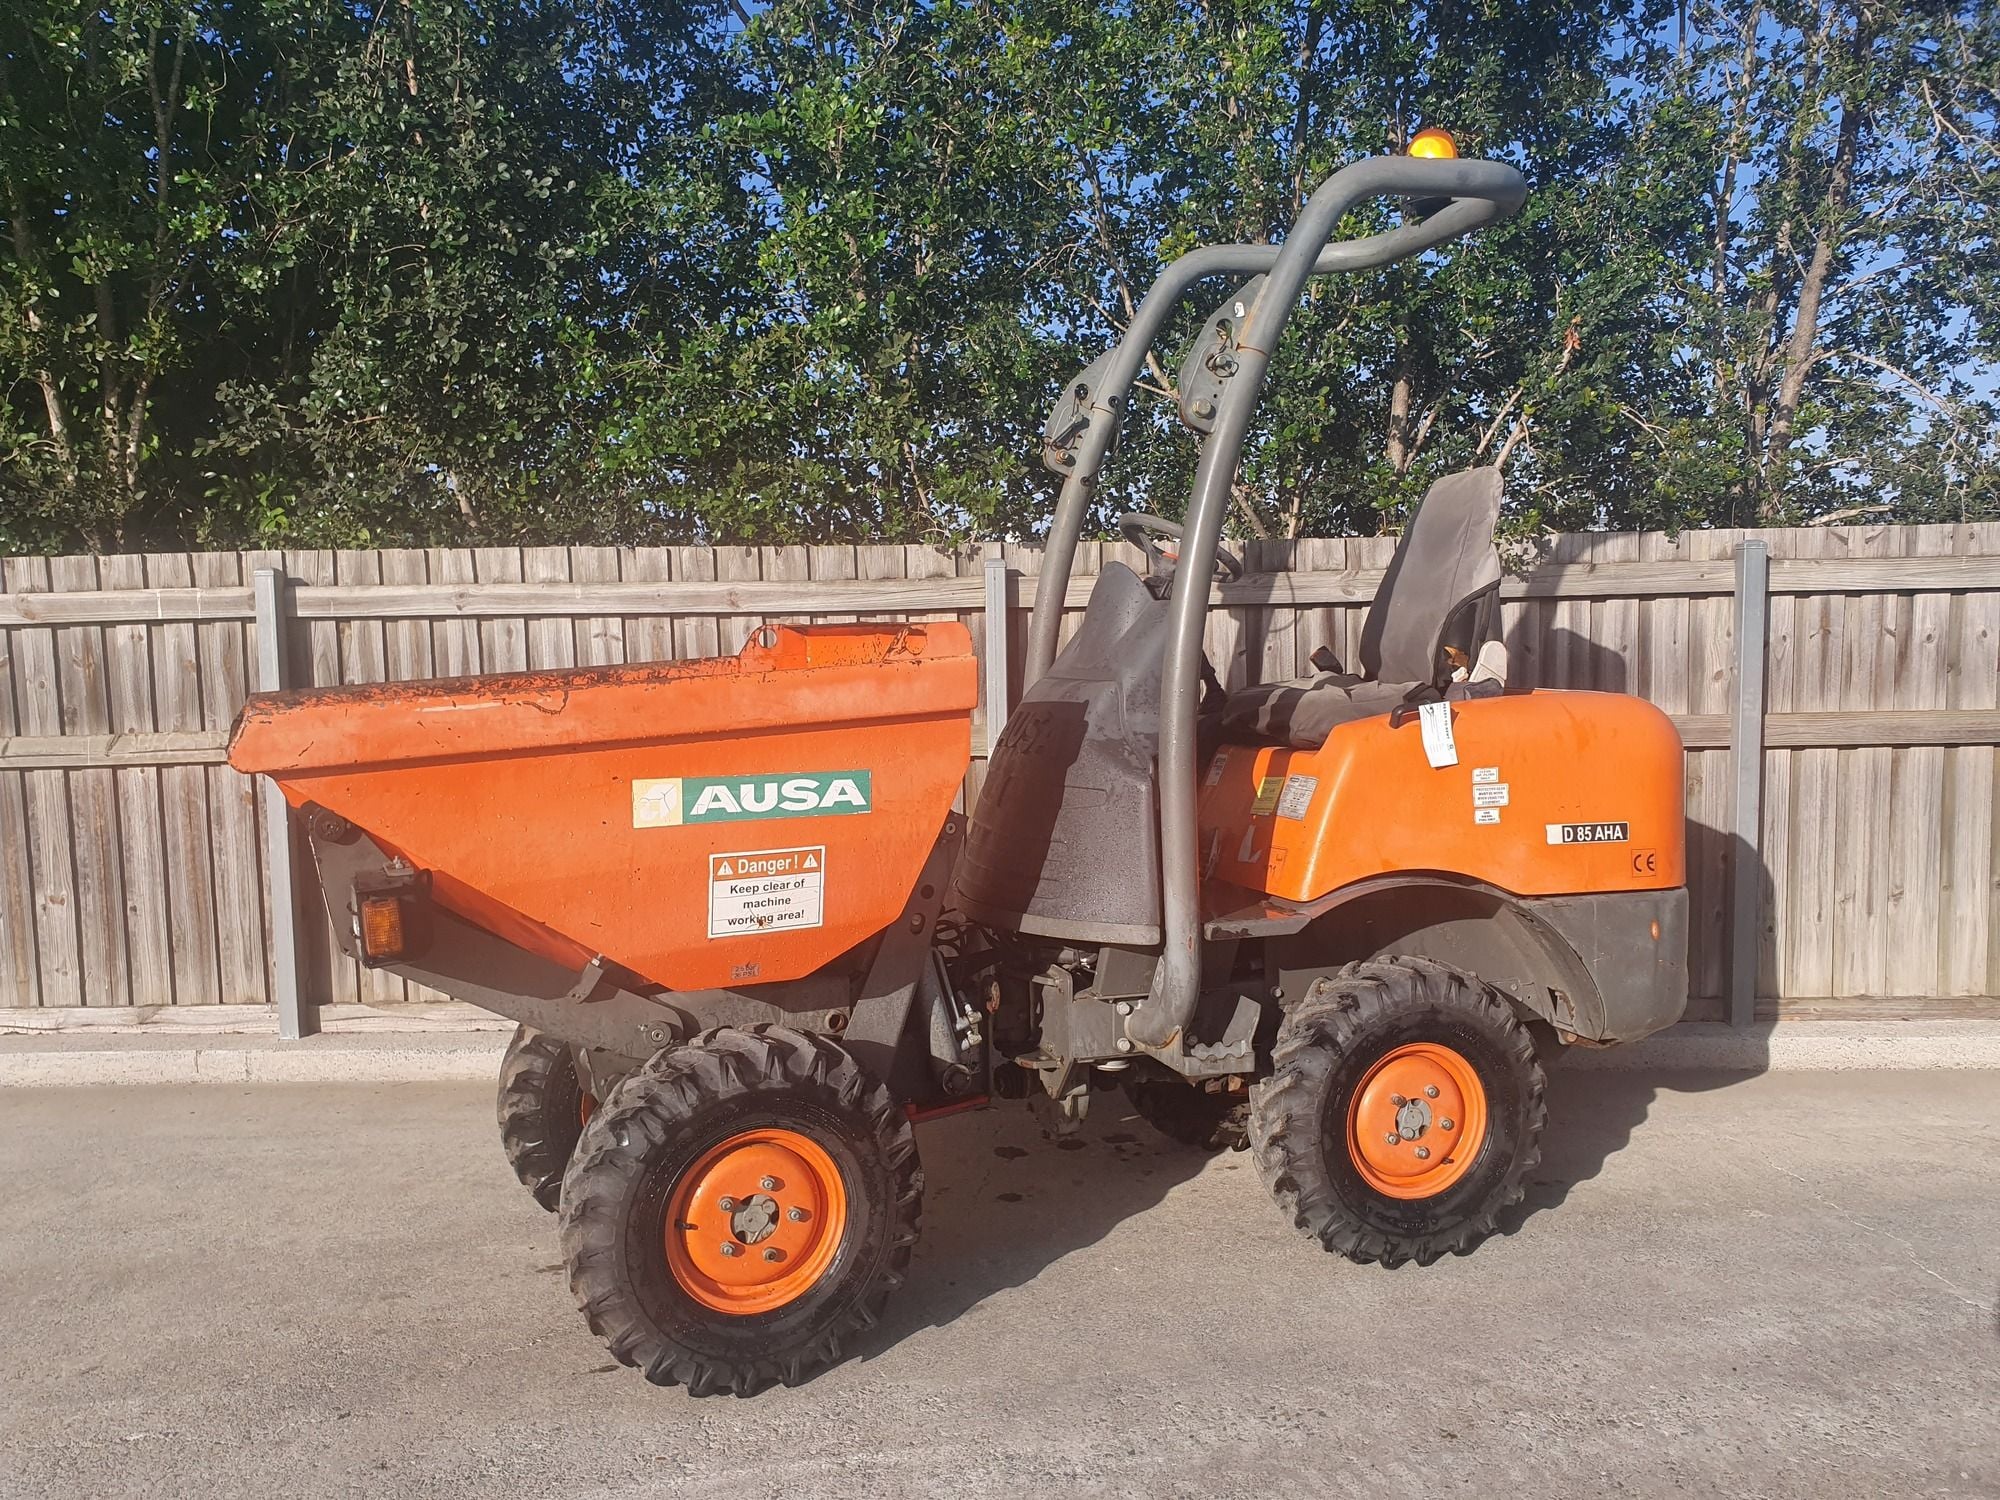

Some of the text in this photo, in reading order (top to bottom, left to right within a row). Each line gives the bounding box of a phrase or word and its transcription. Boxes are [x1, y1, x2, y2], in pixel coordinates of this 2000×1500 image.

[689, 778, 867, 816] AUSA
[1563, 824, 1623, 842] D 85 AHA
[738, 858, 792, 875] Danger
[1633, 853, 1655, 872] CE
[730, 878, 805, 894] Keep clear of
[743, 896, 791, 909] machine
[727, 909, 805, 926] working area!
